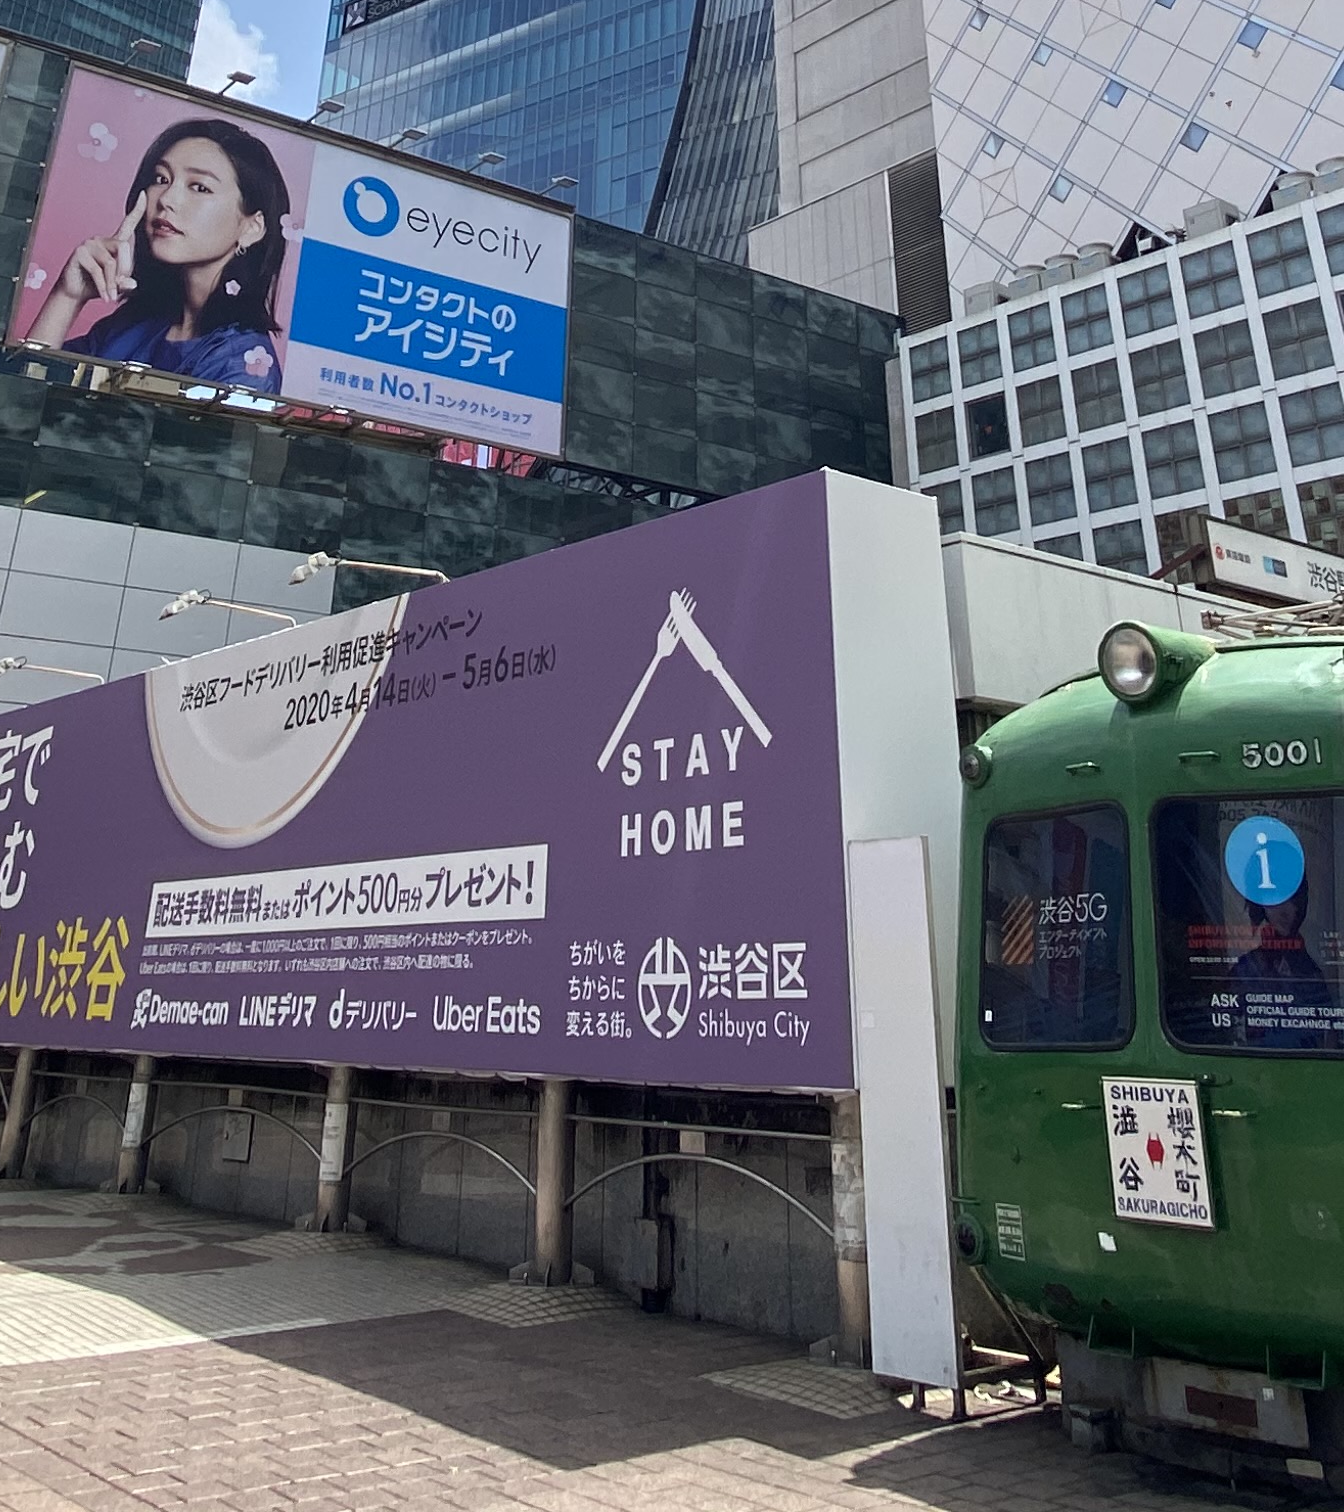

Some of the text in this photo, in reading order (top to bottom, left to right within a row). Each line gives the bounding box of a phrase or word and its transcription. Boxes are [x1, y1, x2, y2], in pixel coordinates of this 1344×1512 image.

[406, 207, 542, 274] eyecity
[358, 268, 517, 333] コンタクトの
[355, 303, 515, 377] アイシティ
[379, 372, 432, 406] No.1
[179, 607, 484, 713] 渋谷区フードデリバリー利用促進キャンペーン
[621, 726, 744, 787] STAY
[1241, 740, 1324, 769] 5001
[620, 800, 745, 858] HOME
[1038, 892, 1108, 925] 渋谷5G
[1039, 927, 1108, 944] エンターテイメント
[568, 939, 627, 967] ちがいを
[698, 942, 809, 1000] 渋谷区
[567, 976, 626, 1001] ちからに
[1210, 993, 1240, 1008] ASK
[1245, 993, 1294, 1004] GUIDE MAP
[149, 992, 229, 1027] Demae-can
[238, 994, 317, 1029] LINEデリマ
[329, 988, 417, 1031] dデリバリー
[432, 995, 542, 1036] Uber Eats
[565, 1010, 633, 1039] 変える街。
[1211, 1013, 1232, 1027] US
[1246, 1006, 1287, 1016] OFFICIAL
[1288, 1007, 1316, 1017] GUIDE
[1247, 1017, 1279, 1028] MONEY
[698, 1009, 811, 1047] Shibuya City
[1110, 1085, 1189, 1104] SHIBUYA
[1118, 1196, 1208, 1220] SAKURAGICHO
